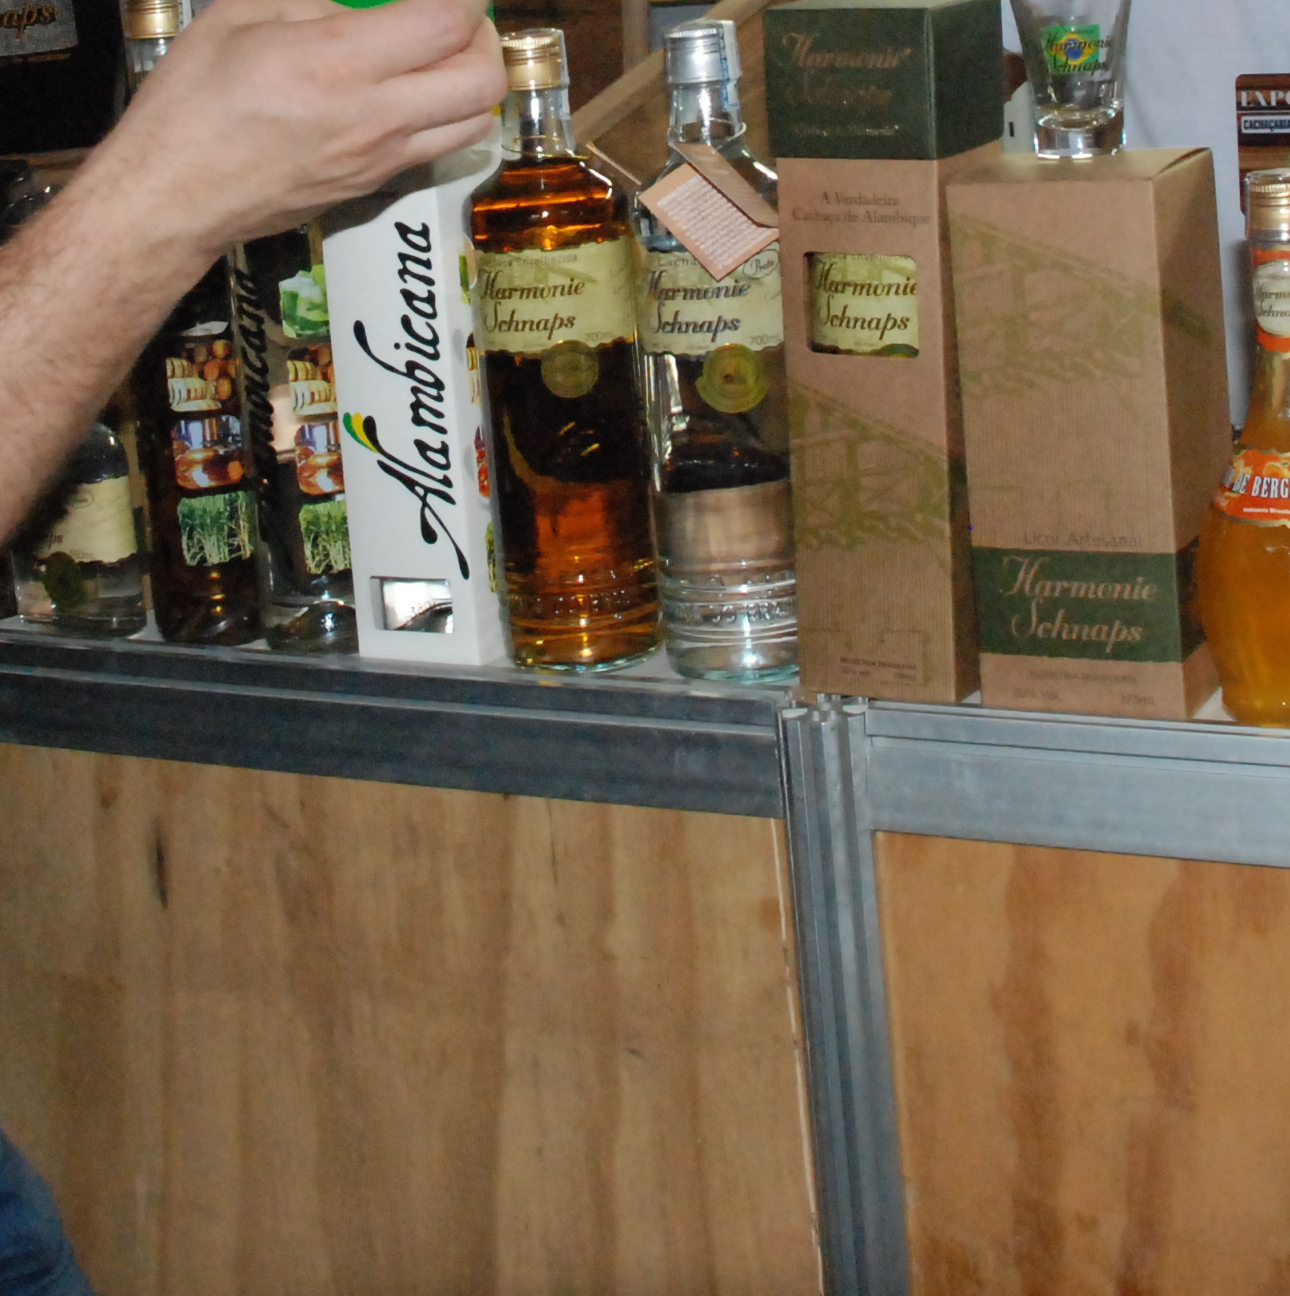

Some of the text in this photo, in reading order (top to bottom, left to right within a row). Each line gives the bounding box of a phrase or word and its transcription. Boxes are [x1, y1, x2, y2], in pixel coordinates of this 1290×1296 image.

[478, 268, 586, 301] Harmonie
[484, 301, 577, 341] Schnaps
[649, 302, 742, 343] Schnaps
[818, 294, 911, 341] Schnaps
[353, 220, 470, 580] Alambicana
[1000, 555, 1158, 601] Harmonie
[1011, 597, 1143, 654] Schnaps
